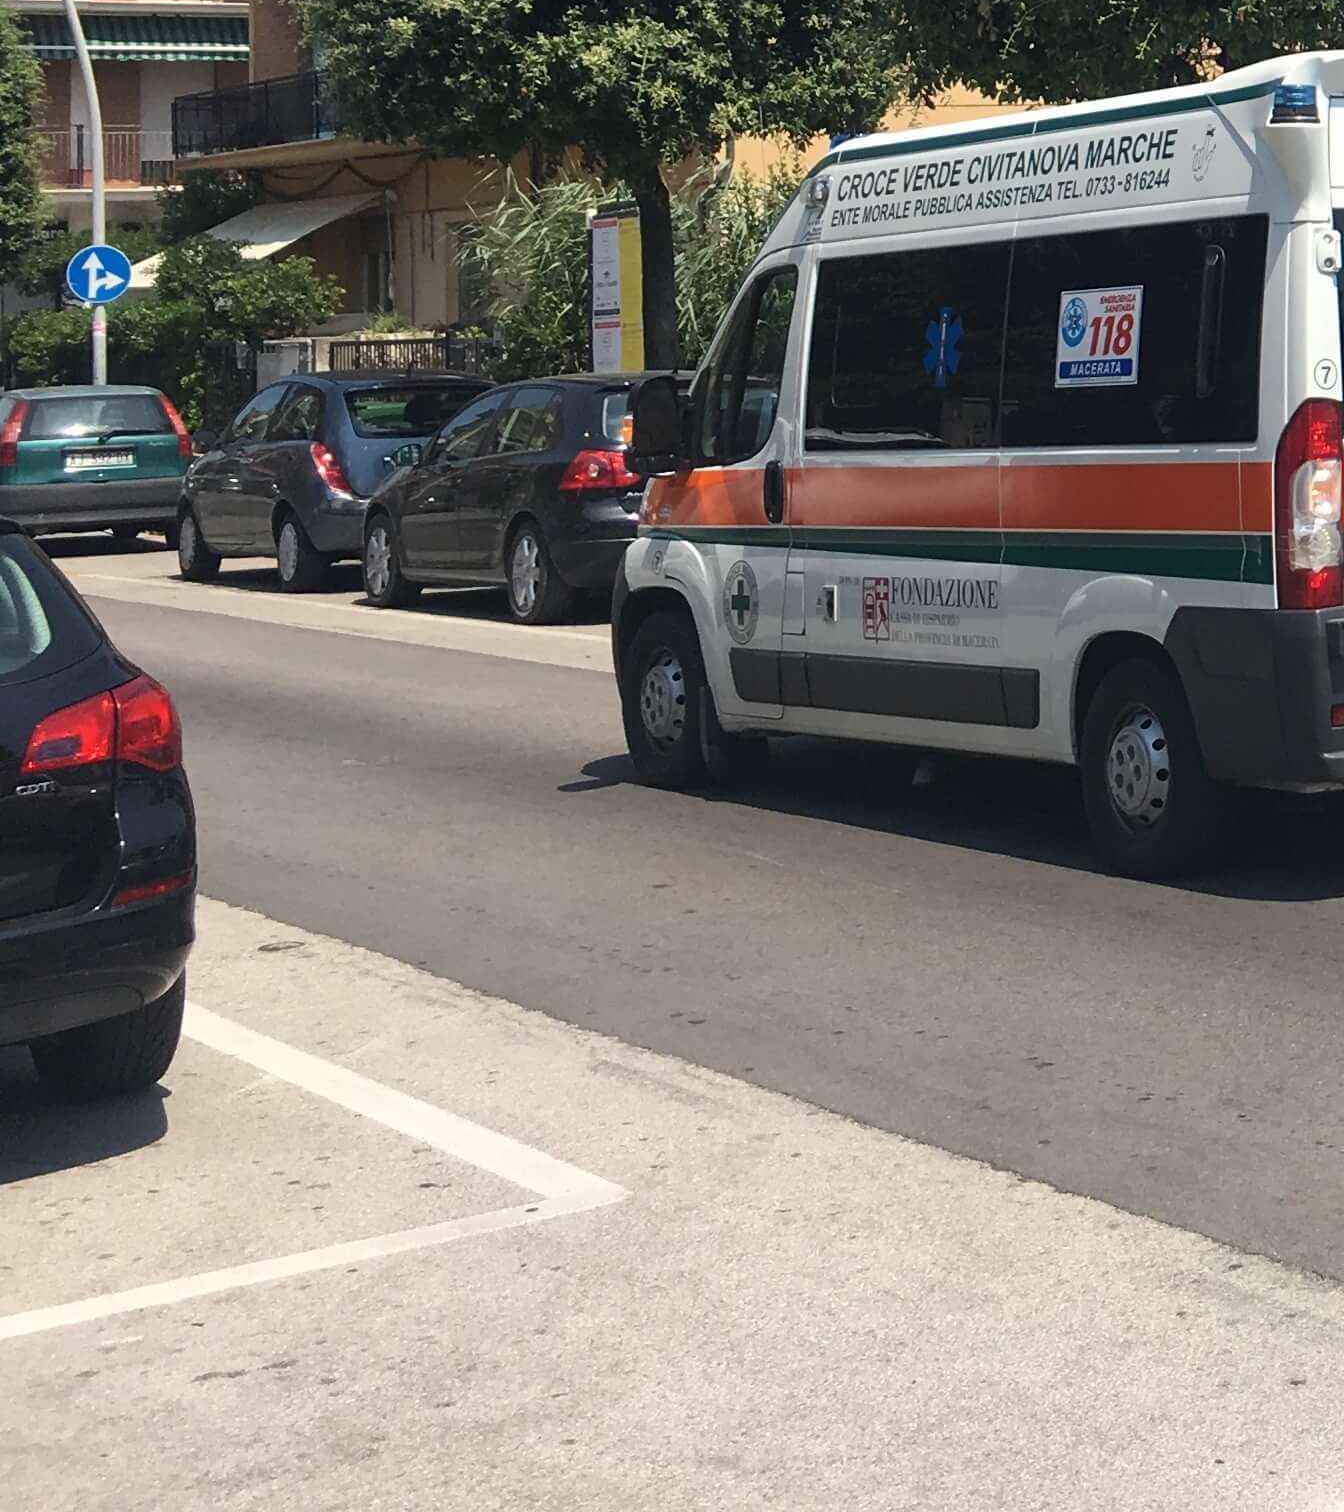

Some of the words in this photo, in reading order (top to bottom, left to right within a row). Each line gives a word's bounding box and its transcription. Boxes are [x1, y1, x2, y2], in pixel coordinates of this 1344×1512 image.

[837, 168, 899, 202] CROCE
[903, 159, 963, 193] VERDE
[967, 143, 1079, 185] CIVITANOVA
[1085, 129, 1178, 169] MARCHE
[831, 207, 861, 227] ENTE
[862, 201, 912, 224] MORALE
[914, 193, 973, 217] PUBBLICA
[975, 181, 1052, 210] ASSISTENZA
[1057, 179, 1083, 200] TEL.
[1089, 313, 1134, 356] 118
[1070, 361, 1121, 376] MACERATA
[1321, 366, 1331, 385] 7
[891, 577, 998, 609] FONDAZIONE
